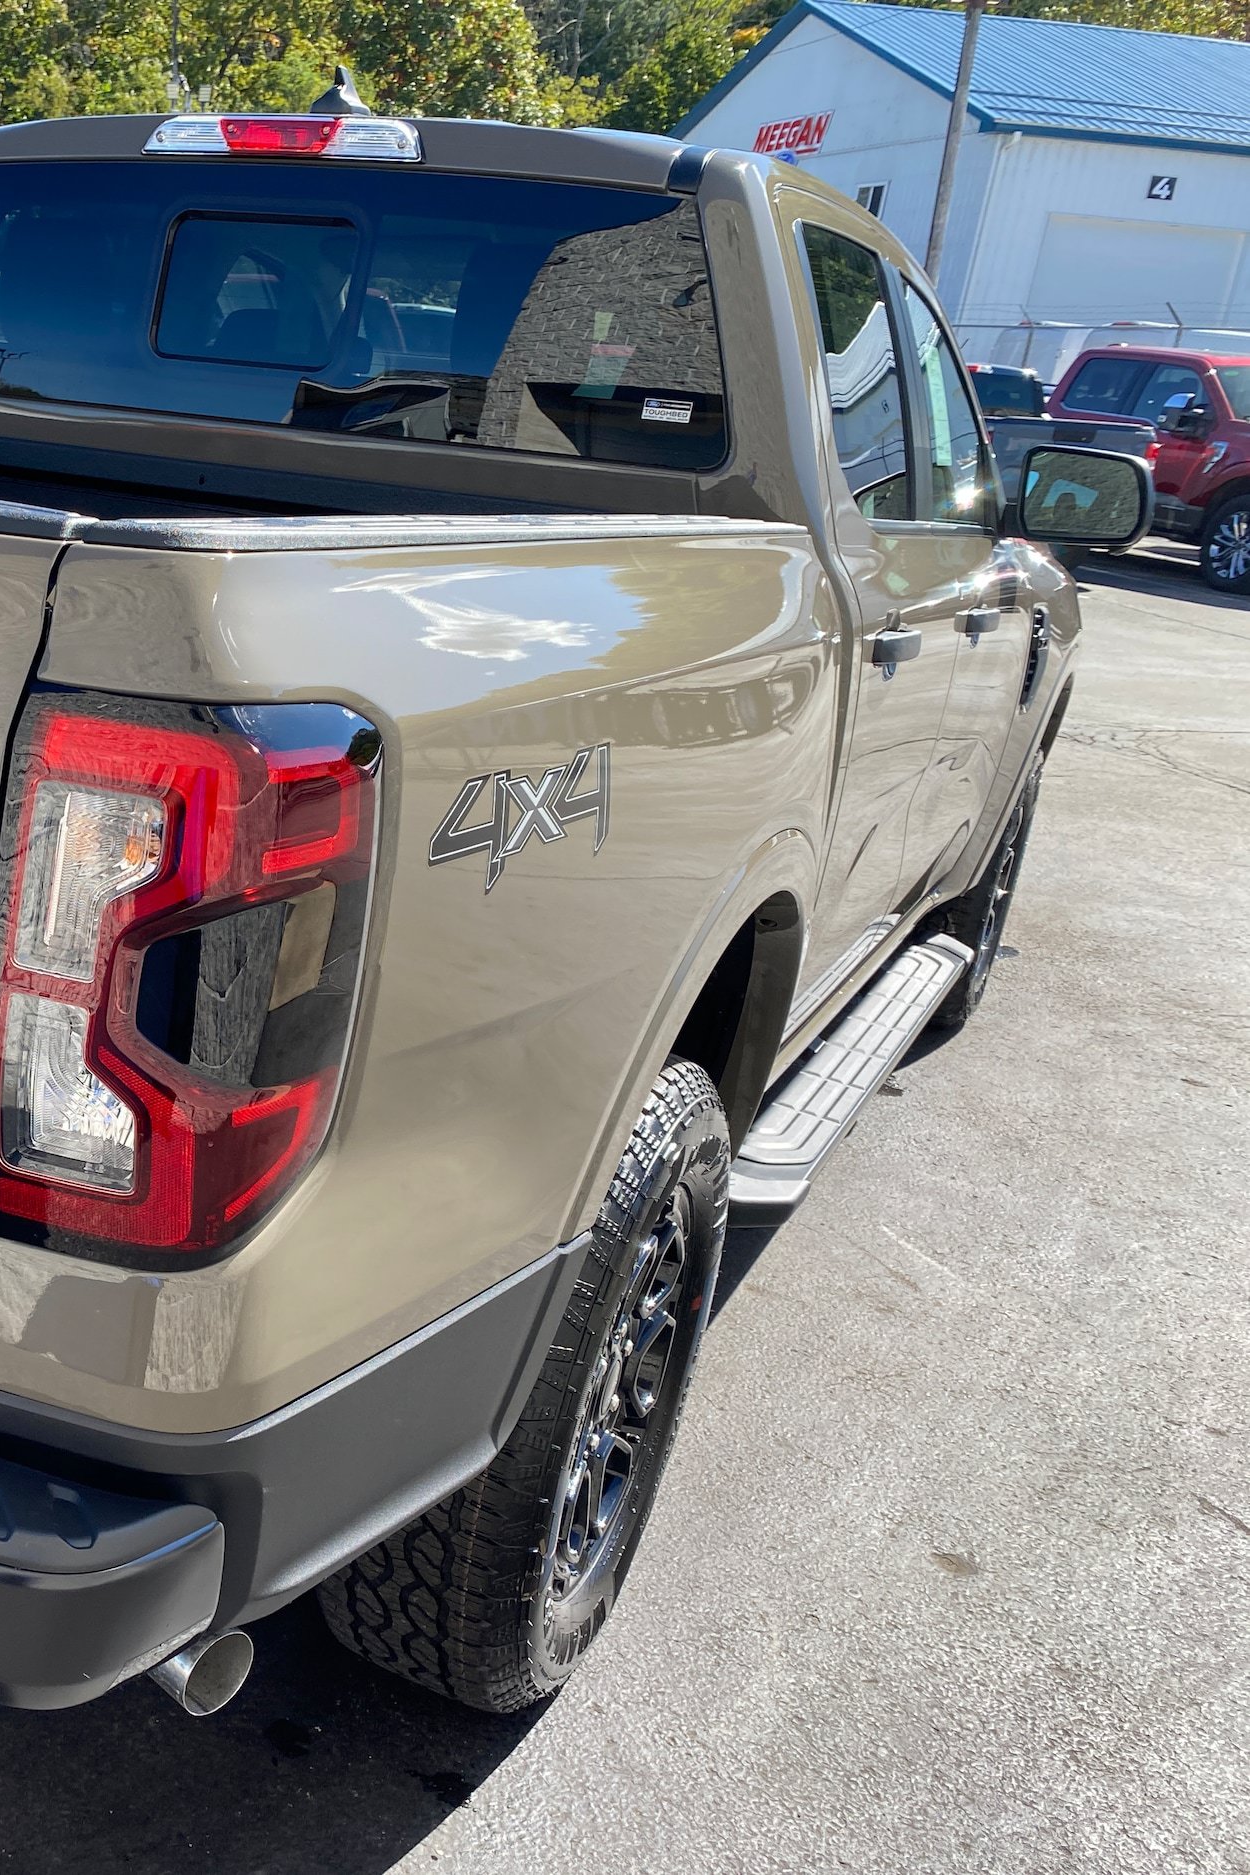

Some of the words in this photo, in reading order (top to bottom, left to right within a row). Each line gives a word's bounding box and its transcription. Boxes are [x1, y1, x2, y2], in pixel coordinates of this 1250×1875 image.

[753, 113, 831, 153] MEEGAN
[1151, 177, 1171, 199] 4
[643, 408, 689, 418] TOUGHBED
